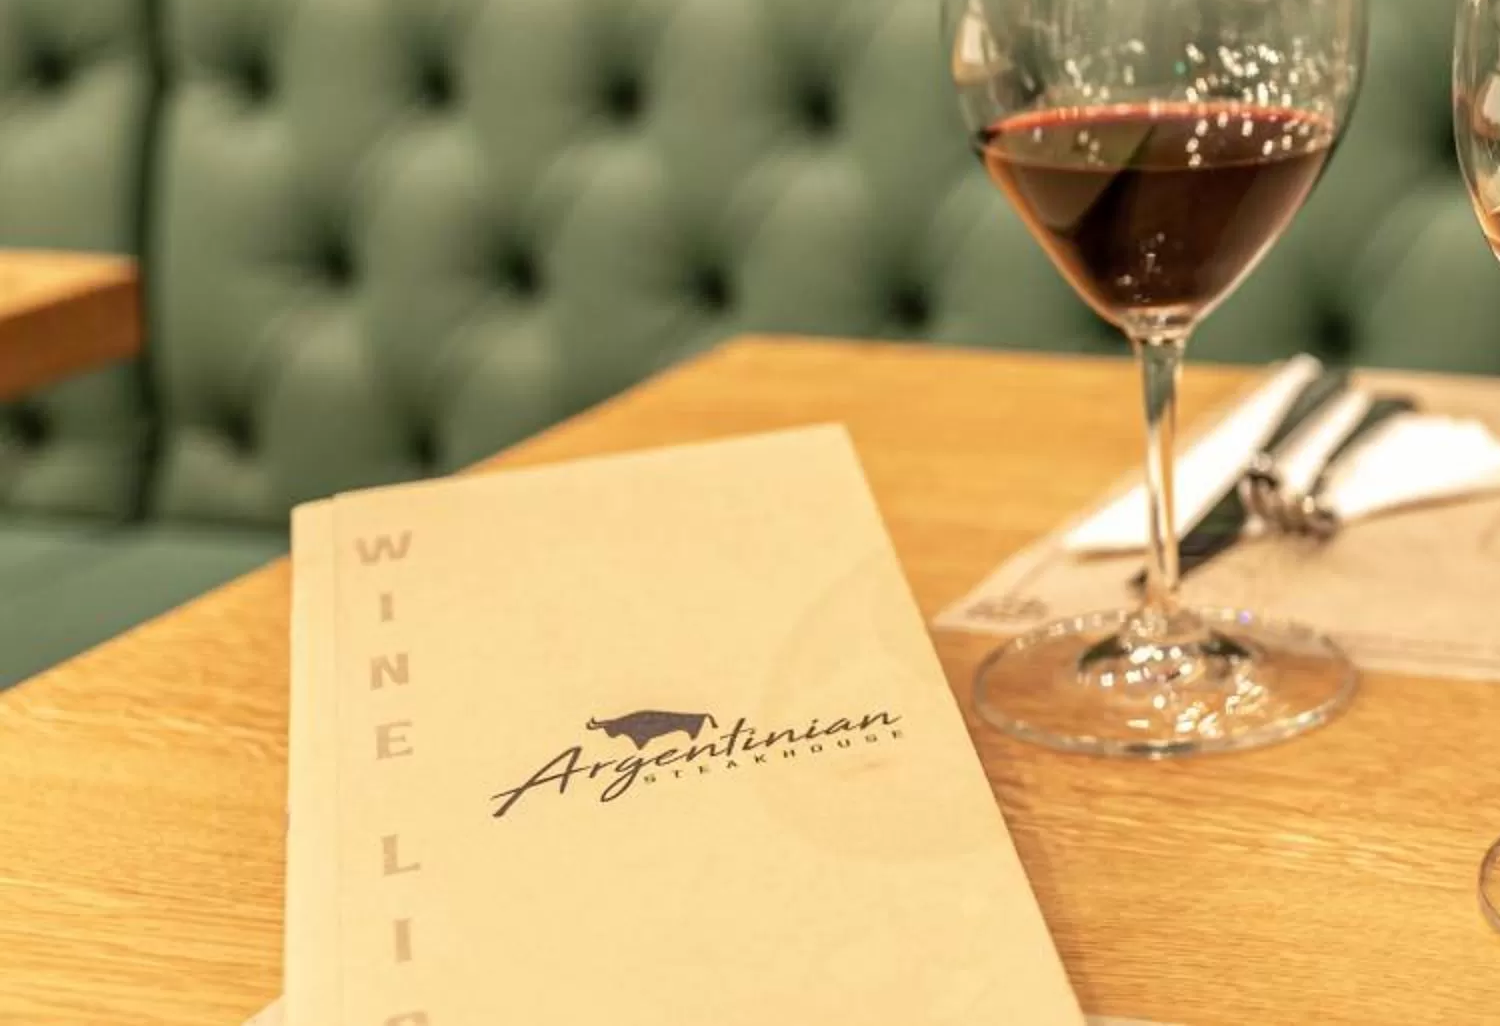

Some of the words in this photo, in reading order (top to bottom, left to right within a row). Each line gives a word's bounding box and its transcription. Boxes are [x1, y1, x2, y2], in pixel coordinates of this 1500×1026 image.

[353, 529, 414, 761] WINE
[492, 709, 902, 818] Argentinian
[643, 728, 906, 784] STEAKHOUSE
